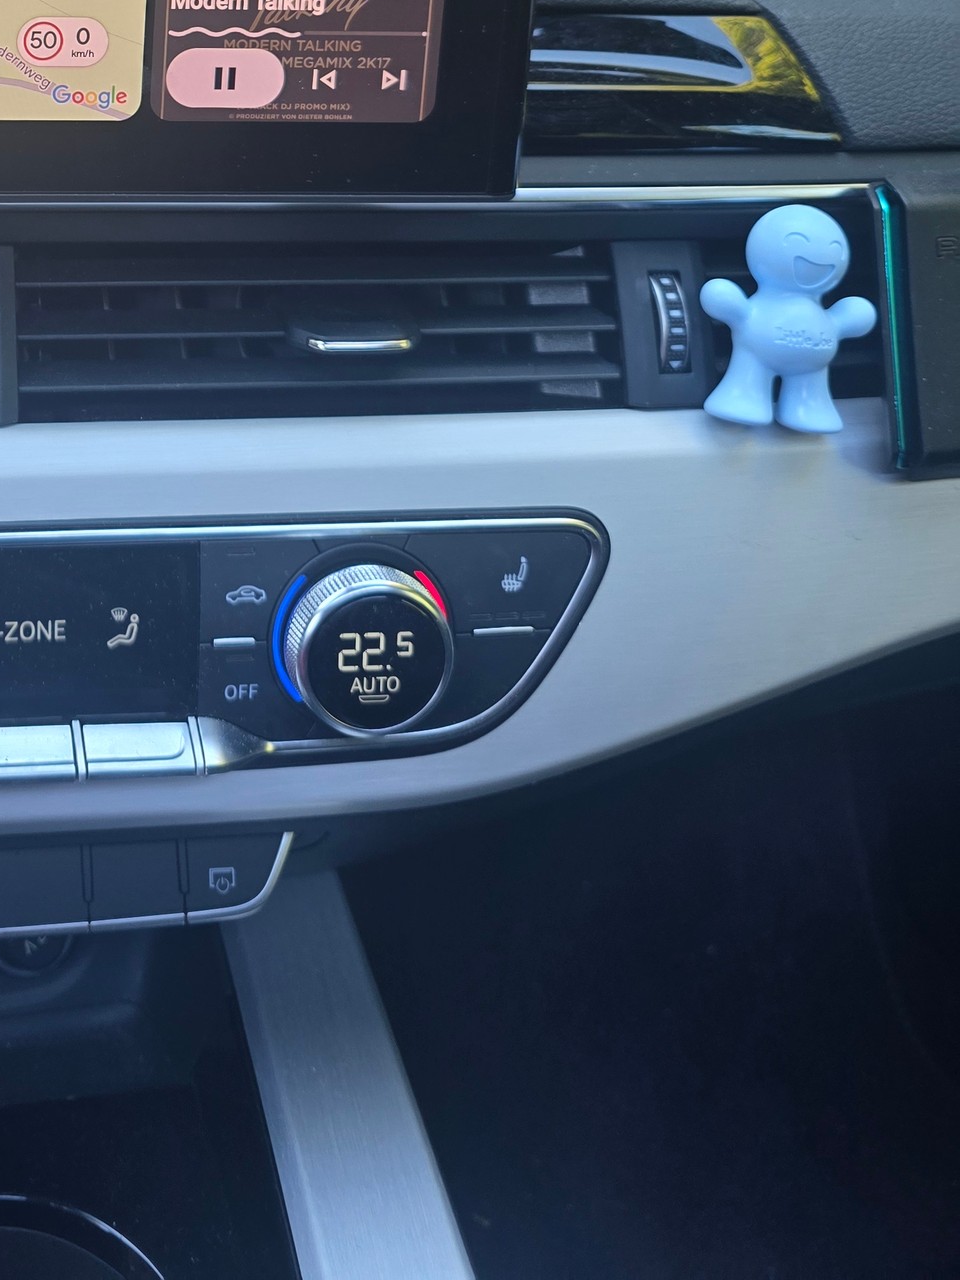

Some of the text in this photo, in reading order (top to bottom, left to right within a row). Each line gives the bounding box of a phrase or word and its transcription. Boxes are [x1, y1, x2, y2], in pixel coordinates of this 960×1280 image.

[29, 30, 58, 50] 50
[76, 28, 90, 46] 0
[224, 39, 362, 52] MODERN TALKING
[71, 49, 95, 58] km/h
[281, 57, 391, 69] MEGAMIX 2K17
[51, 84, 128, 110] Google
[337, 630, 415, 673] 22.5
[224, 684, 259, 700] OFF
[350, 677, 401, 694] AUTO
